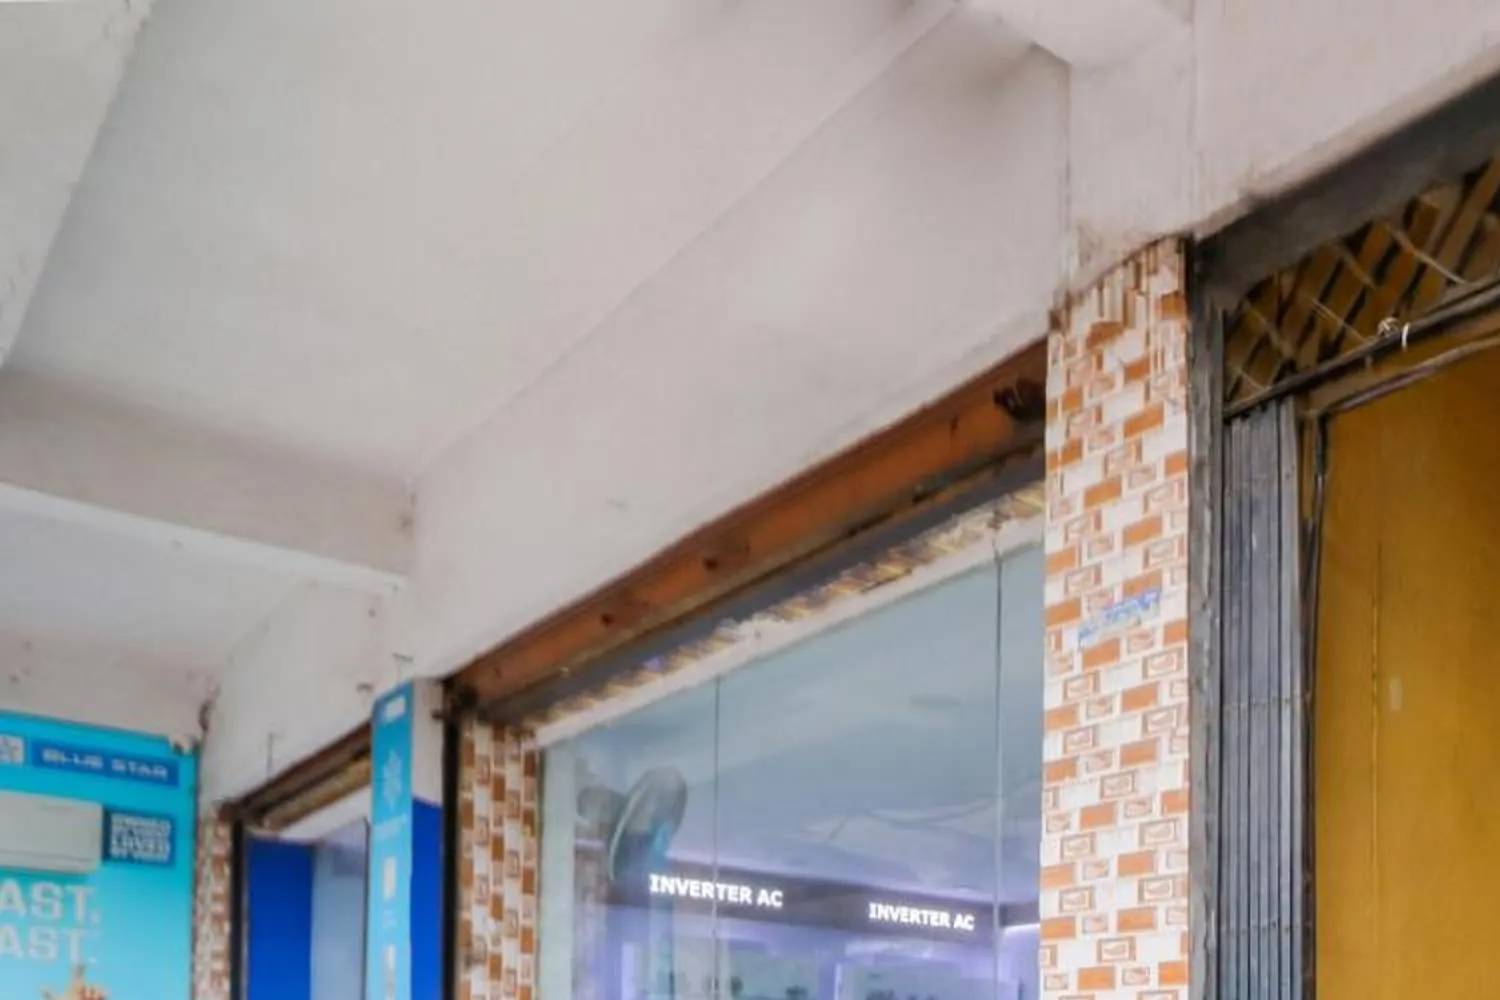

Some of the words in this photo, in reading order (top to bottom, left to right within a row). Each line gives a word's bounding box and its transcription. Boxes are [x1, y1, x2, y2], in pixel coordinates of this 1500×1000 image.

[650, 873, 753, 904] INVERTER
[757, 889, 784, 909] AC
[868, 902, 951, 928] INVERTER
[953, 912, 976, 931] AC
